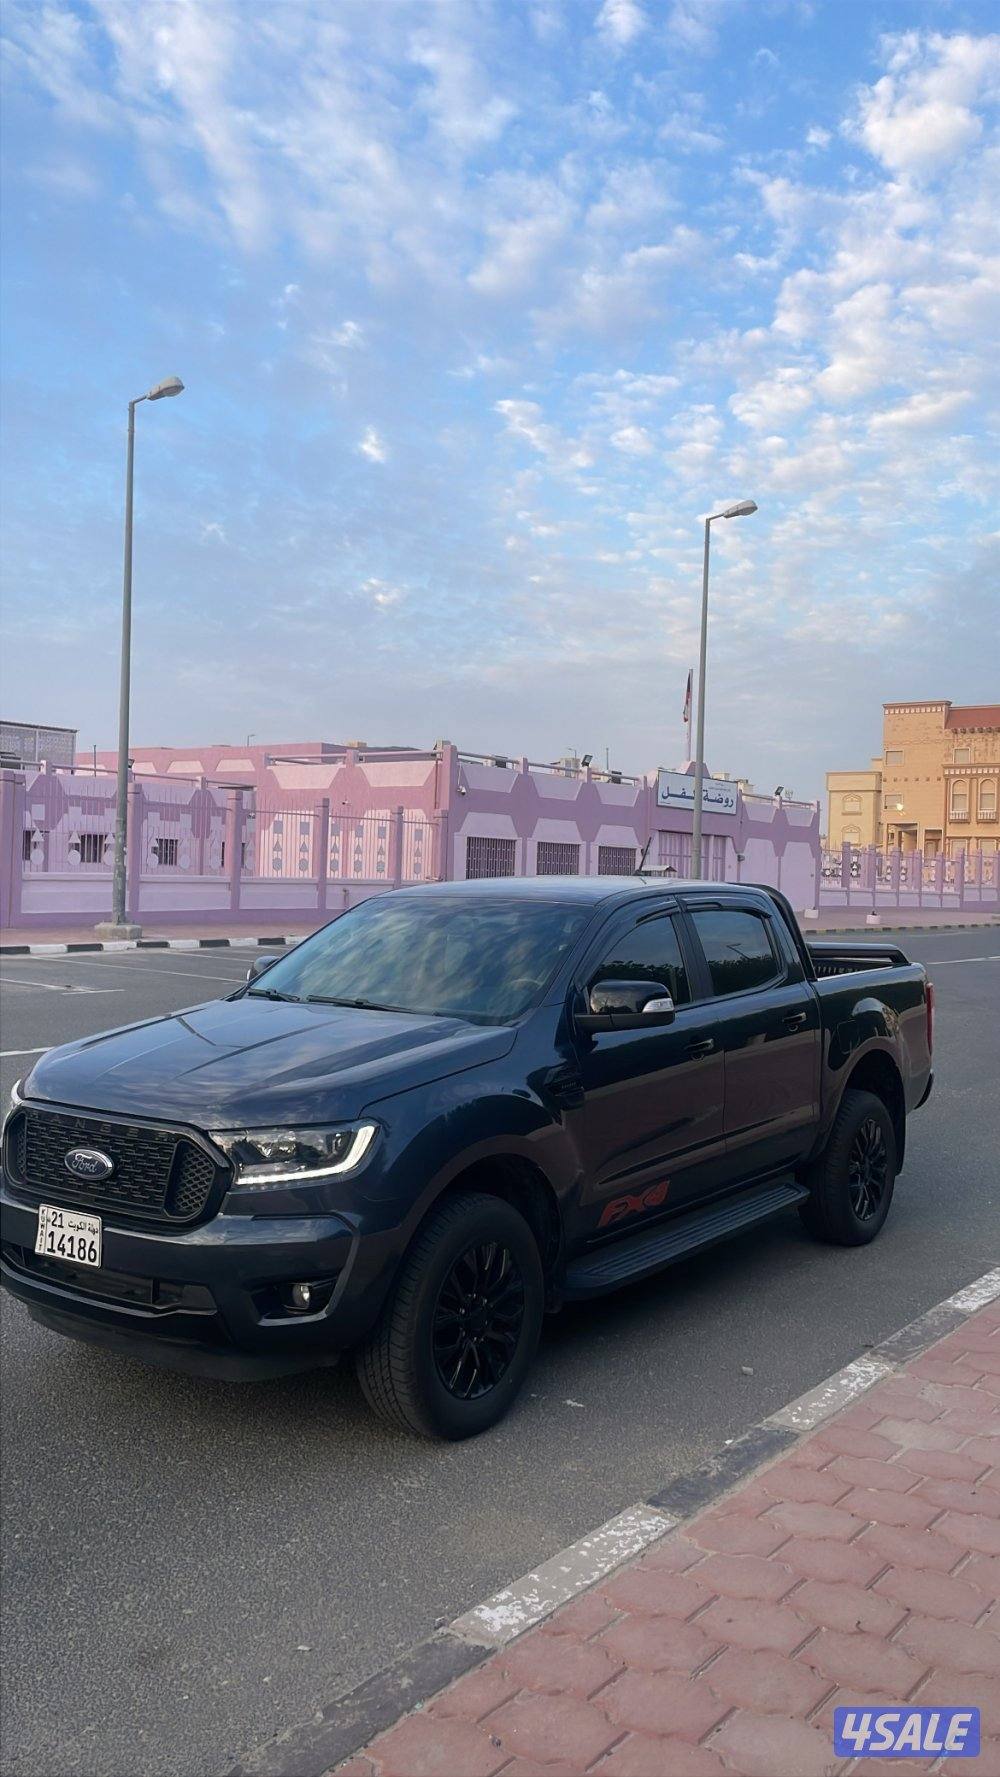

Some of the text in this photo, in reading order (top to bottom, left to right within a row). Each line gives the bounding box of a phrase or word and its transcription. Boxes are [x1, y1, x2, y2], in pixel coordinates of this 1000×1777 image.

[702, 789, 734, 808] روضة
[72, 1153, 99, 1173] Ford
[597, 1180, 670, 1229] FX4
[51, 1211, 64, 1229] 21
[67, 1220, 99, 1236] دولة الكويت
[46, 1230, 97, 1263] 14186
